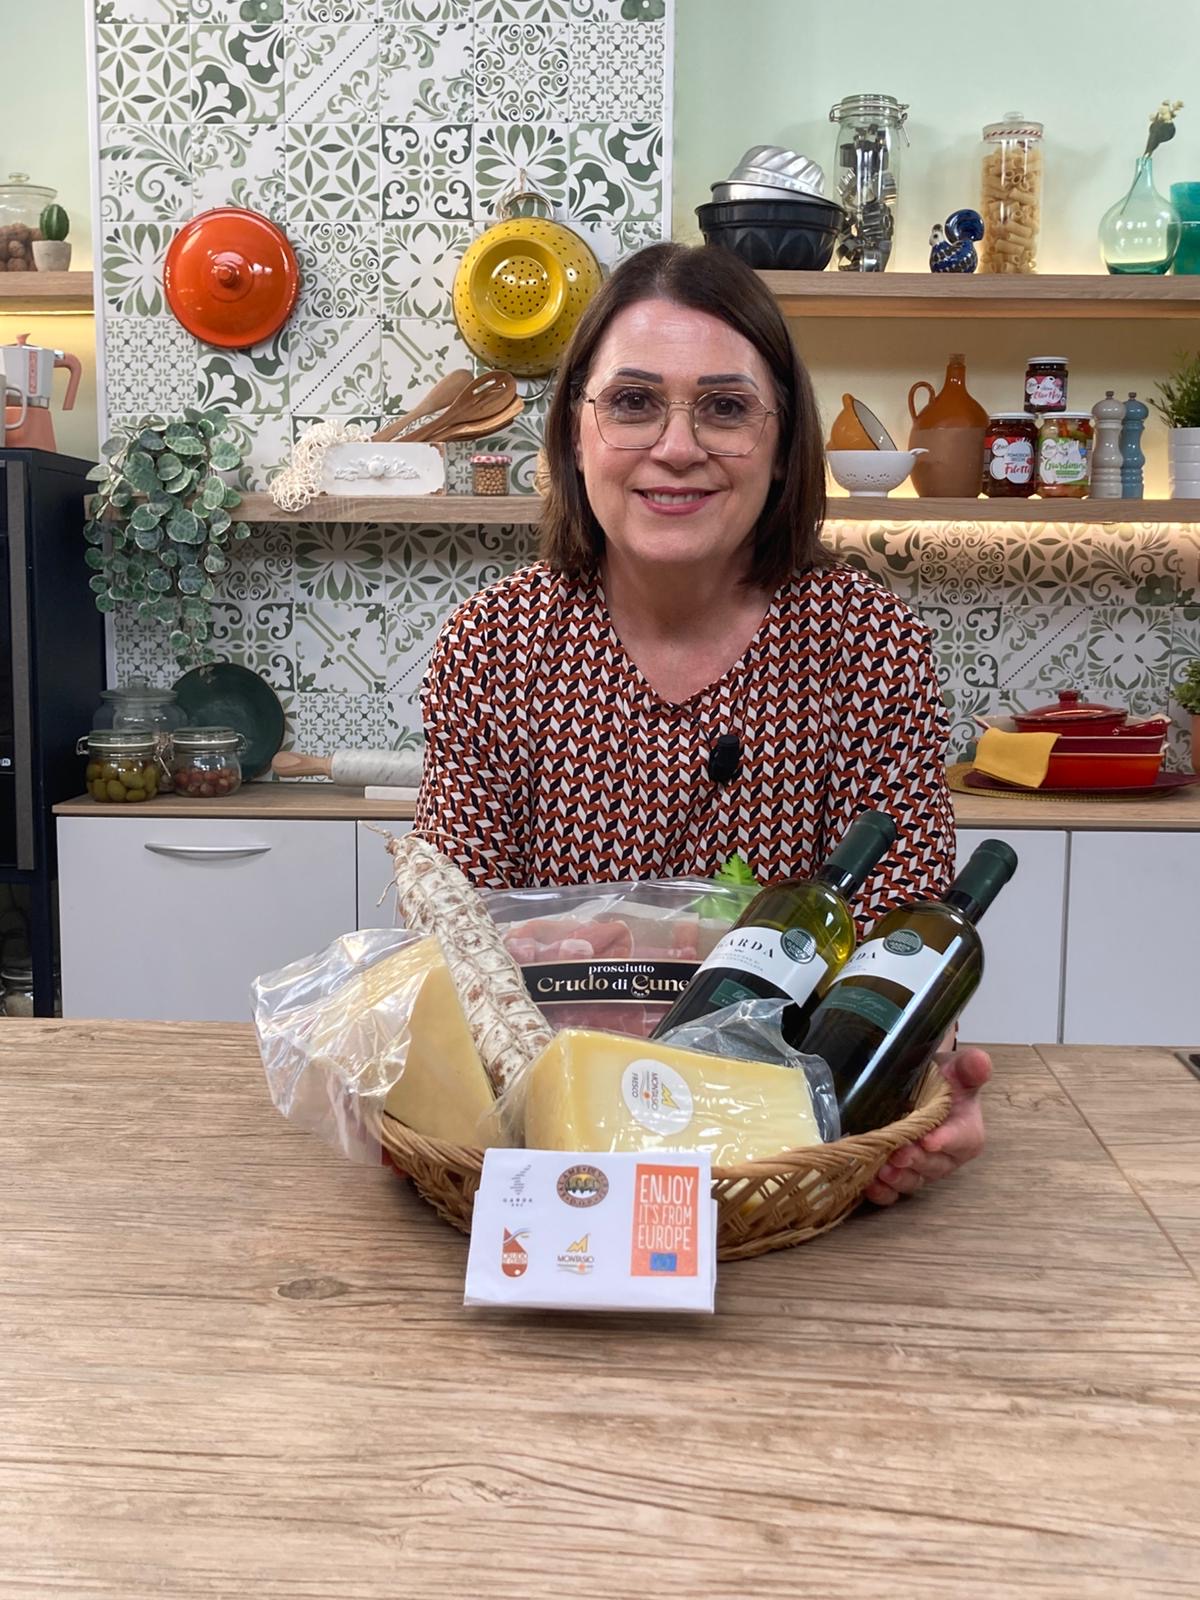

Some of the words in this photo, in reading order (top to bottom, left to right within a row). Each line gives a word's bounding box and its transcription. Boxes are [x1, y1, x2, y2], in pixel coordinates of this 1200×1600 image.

[717, 938, 774, 958] ARDA
[588, 963, 655, 975] prosciutto
[537, 974, 609, 993] Crudo
[611, 978, 628, 991] di
[631, 974, 690, 993] Cune
[640, 1174, 694, 1206] ENJOY
[638, 1204, 659, 1225] IT'S
[661, 1204, 693, 1226] FROM
[637, 1224, 693, 1251] EUROPE
[557, 1255, 595, 1263] MONTASIO
